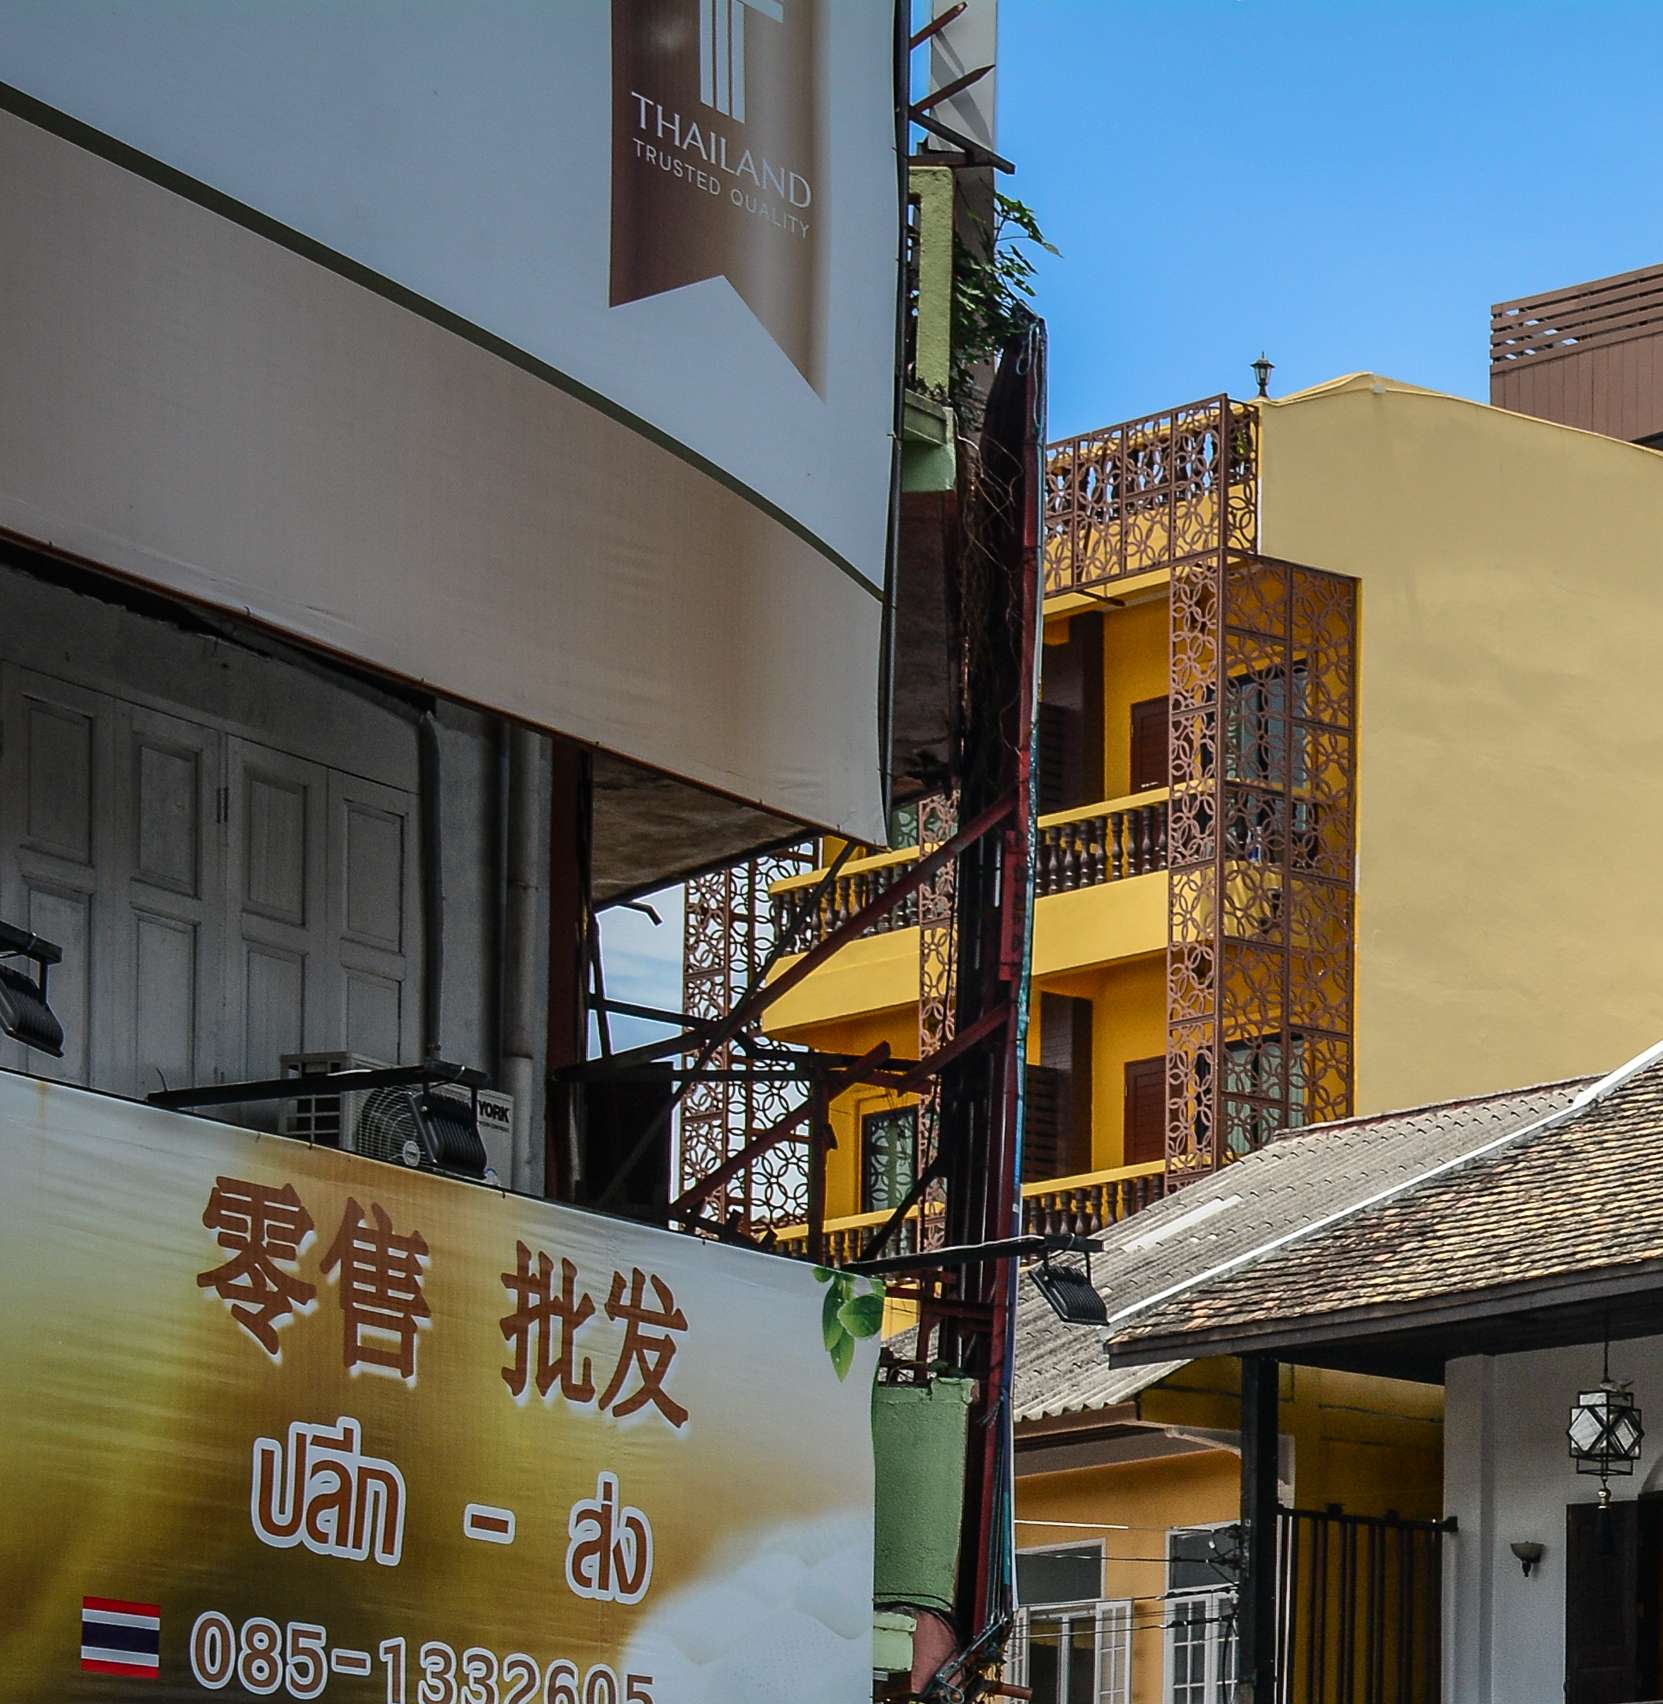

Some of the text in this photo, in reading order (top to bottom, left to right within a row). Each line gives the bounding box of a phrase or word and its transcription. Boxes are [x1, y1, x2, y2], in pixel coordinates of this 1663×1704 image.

[631, 90, 812, 209] THAILAND
[632, 137, 810, 239] TRUSTED QUALITY
[480, 1101, 510, 1123] YORK
[196, 1175, 690, 1428] 零售 批发
[252, 1417, 405, 1566] ปลีก
[566, 1472, 653, 1603] ส่ง
